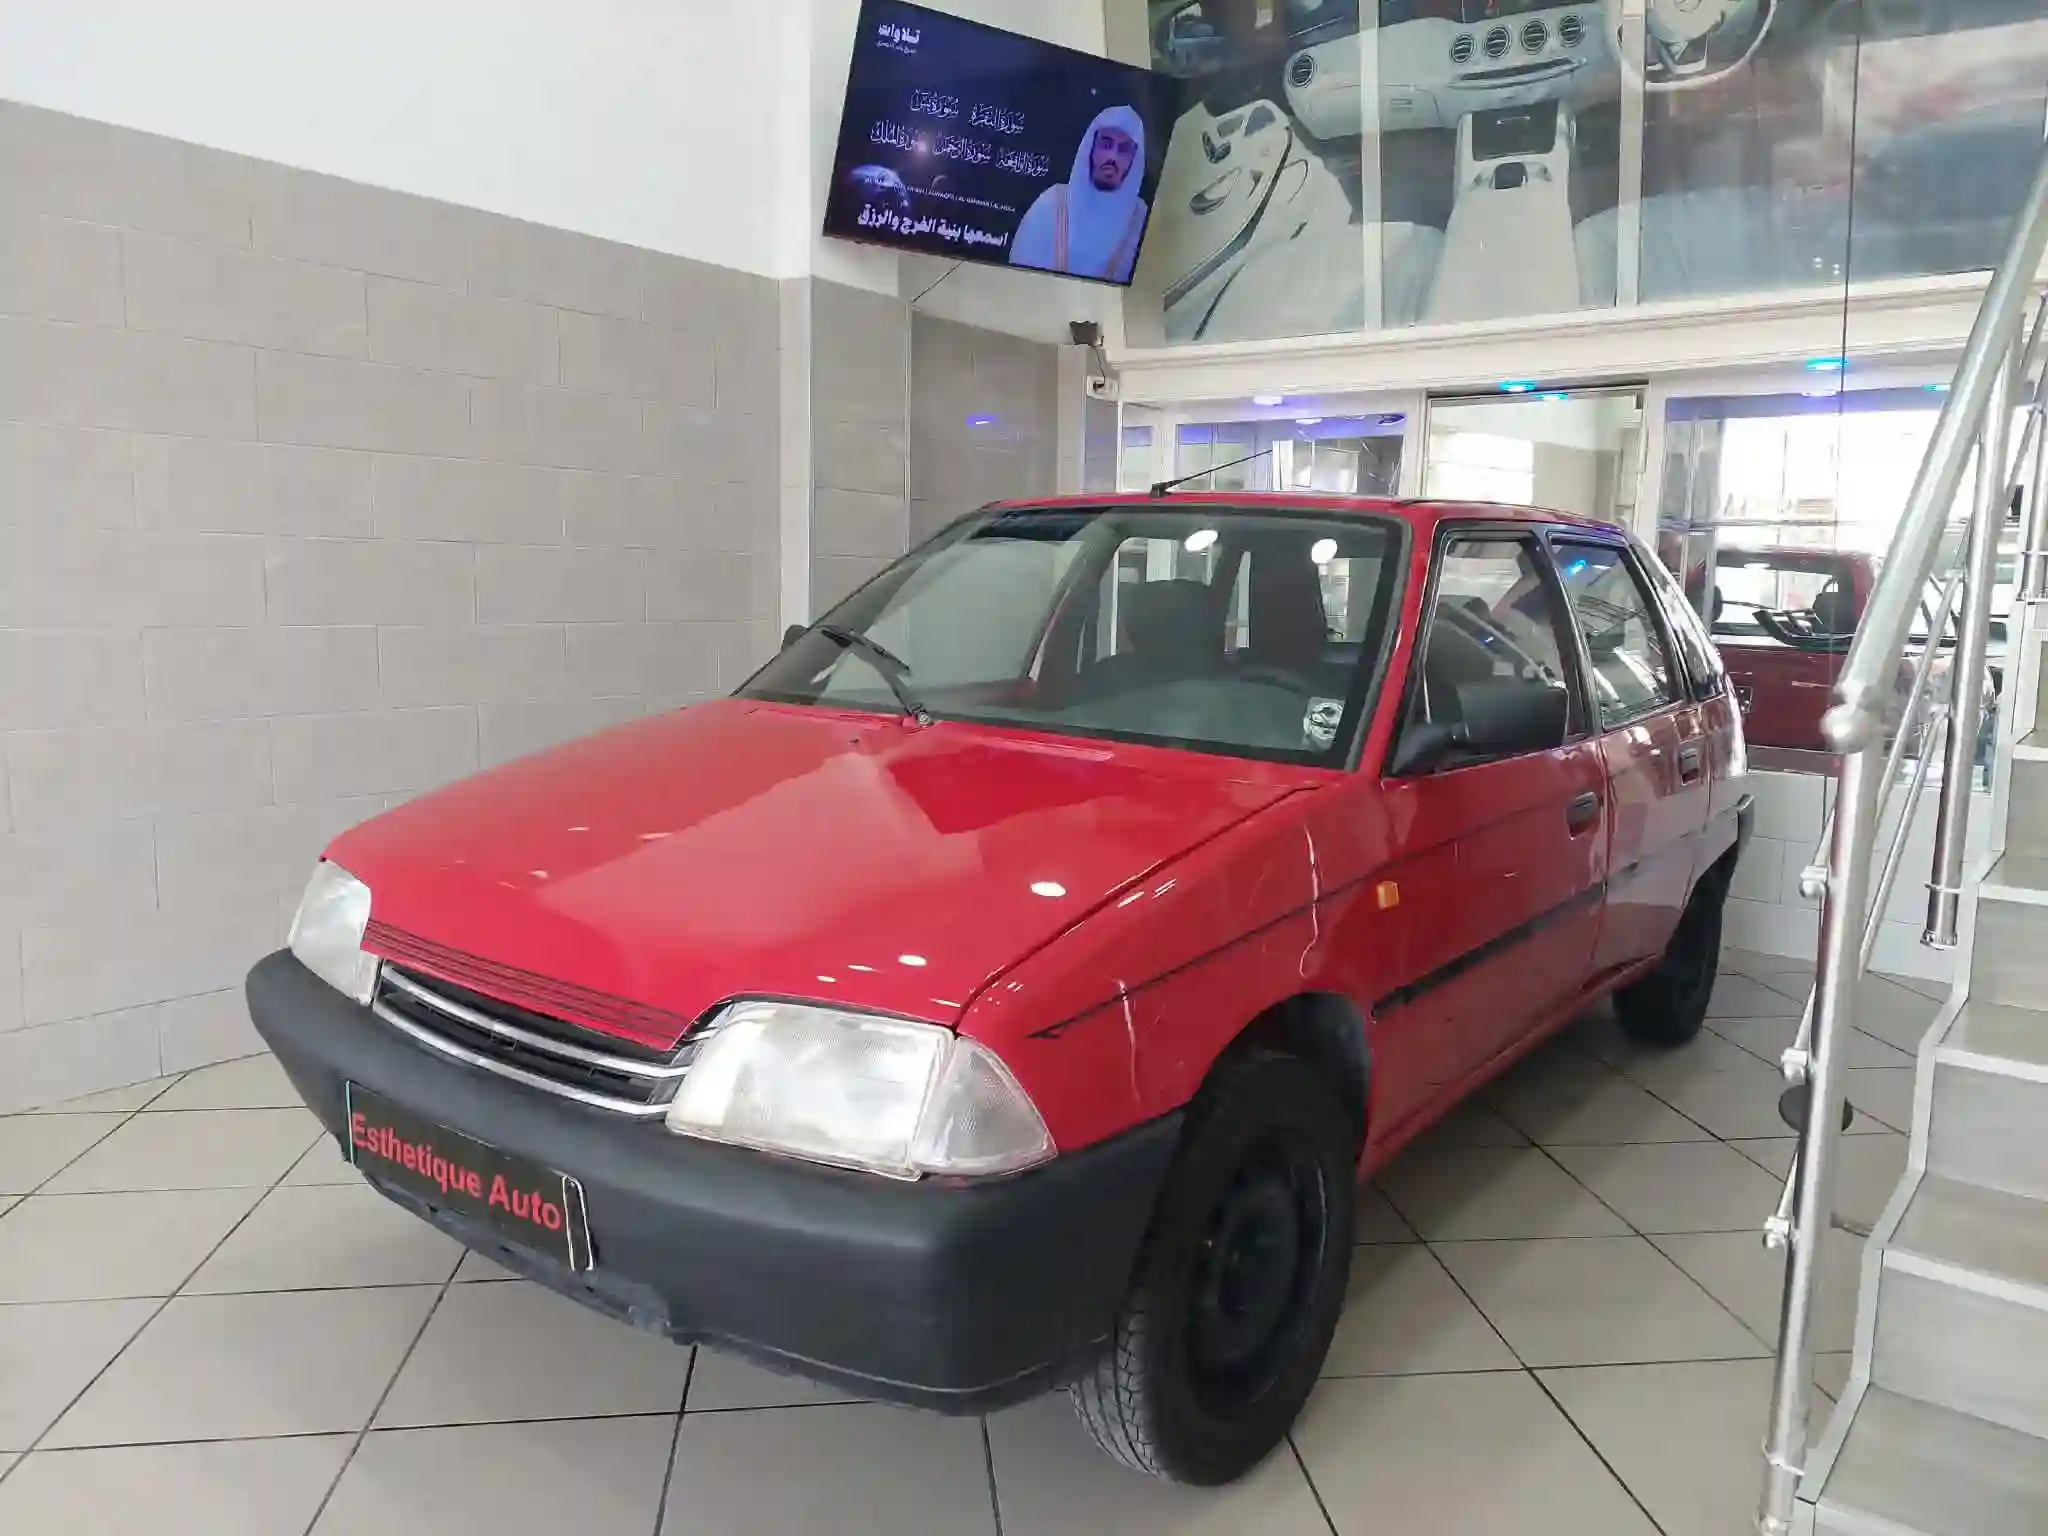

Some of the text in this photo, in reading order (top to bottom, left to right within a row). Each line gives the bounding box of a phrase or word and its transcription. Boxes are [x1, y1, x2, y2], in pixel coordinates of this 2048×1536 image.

[878, 23, 921, 44] تلاوات
[857, 203, 1009, 247] اسمعها بنية الفرج والرزق
[351, 1112, 562, 1230] Esthetique Auto
